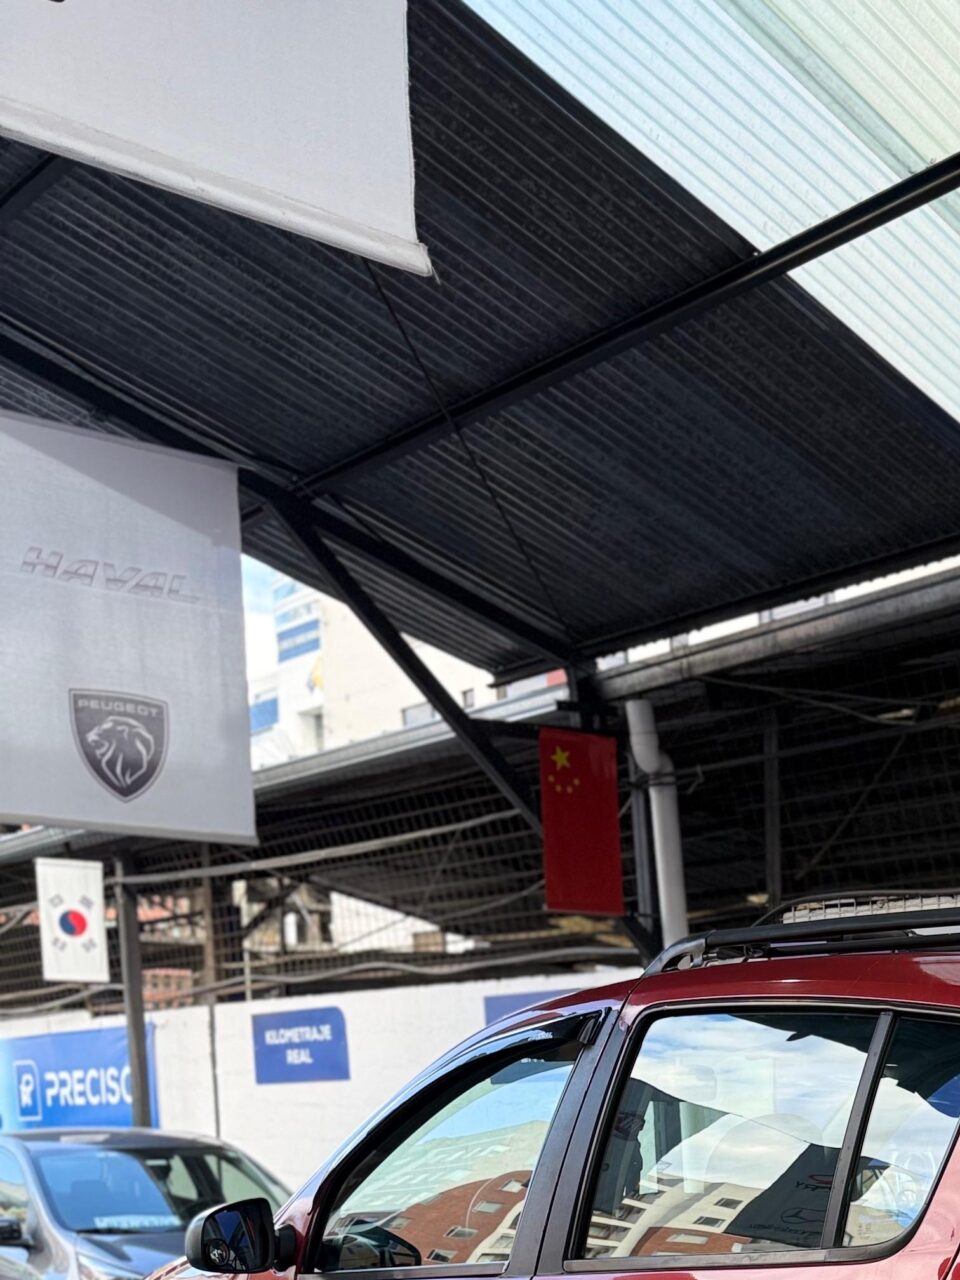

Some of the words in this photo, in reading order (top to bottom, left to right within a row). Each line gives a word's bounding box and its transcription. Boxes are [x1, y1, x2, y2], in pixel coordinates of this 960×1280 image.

[19, 546, 200, 604] HAVAL
[76, 698, 160, 717] PEUGEOT
[285, 1048, 314, 1065] REAL
